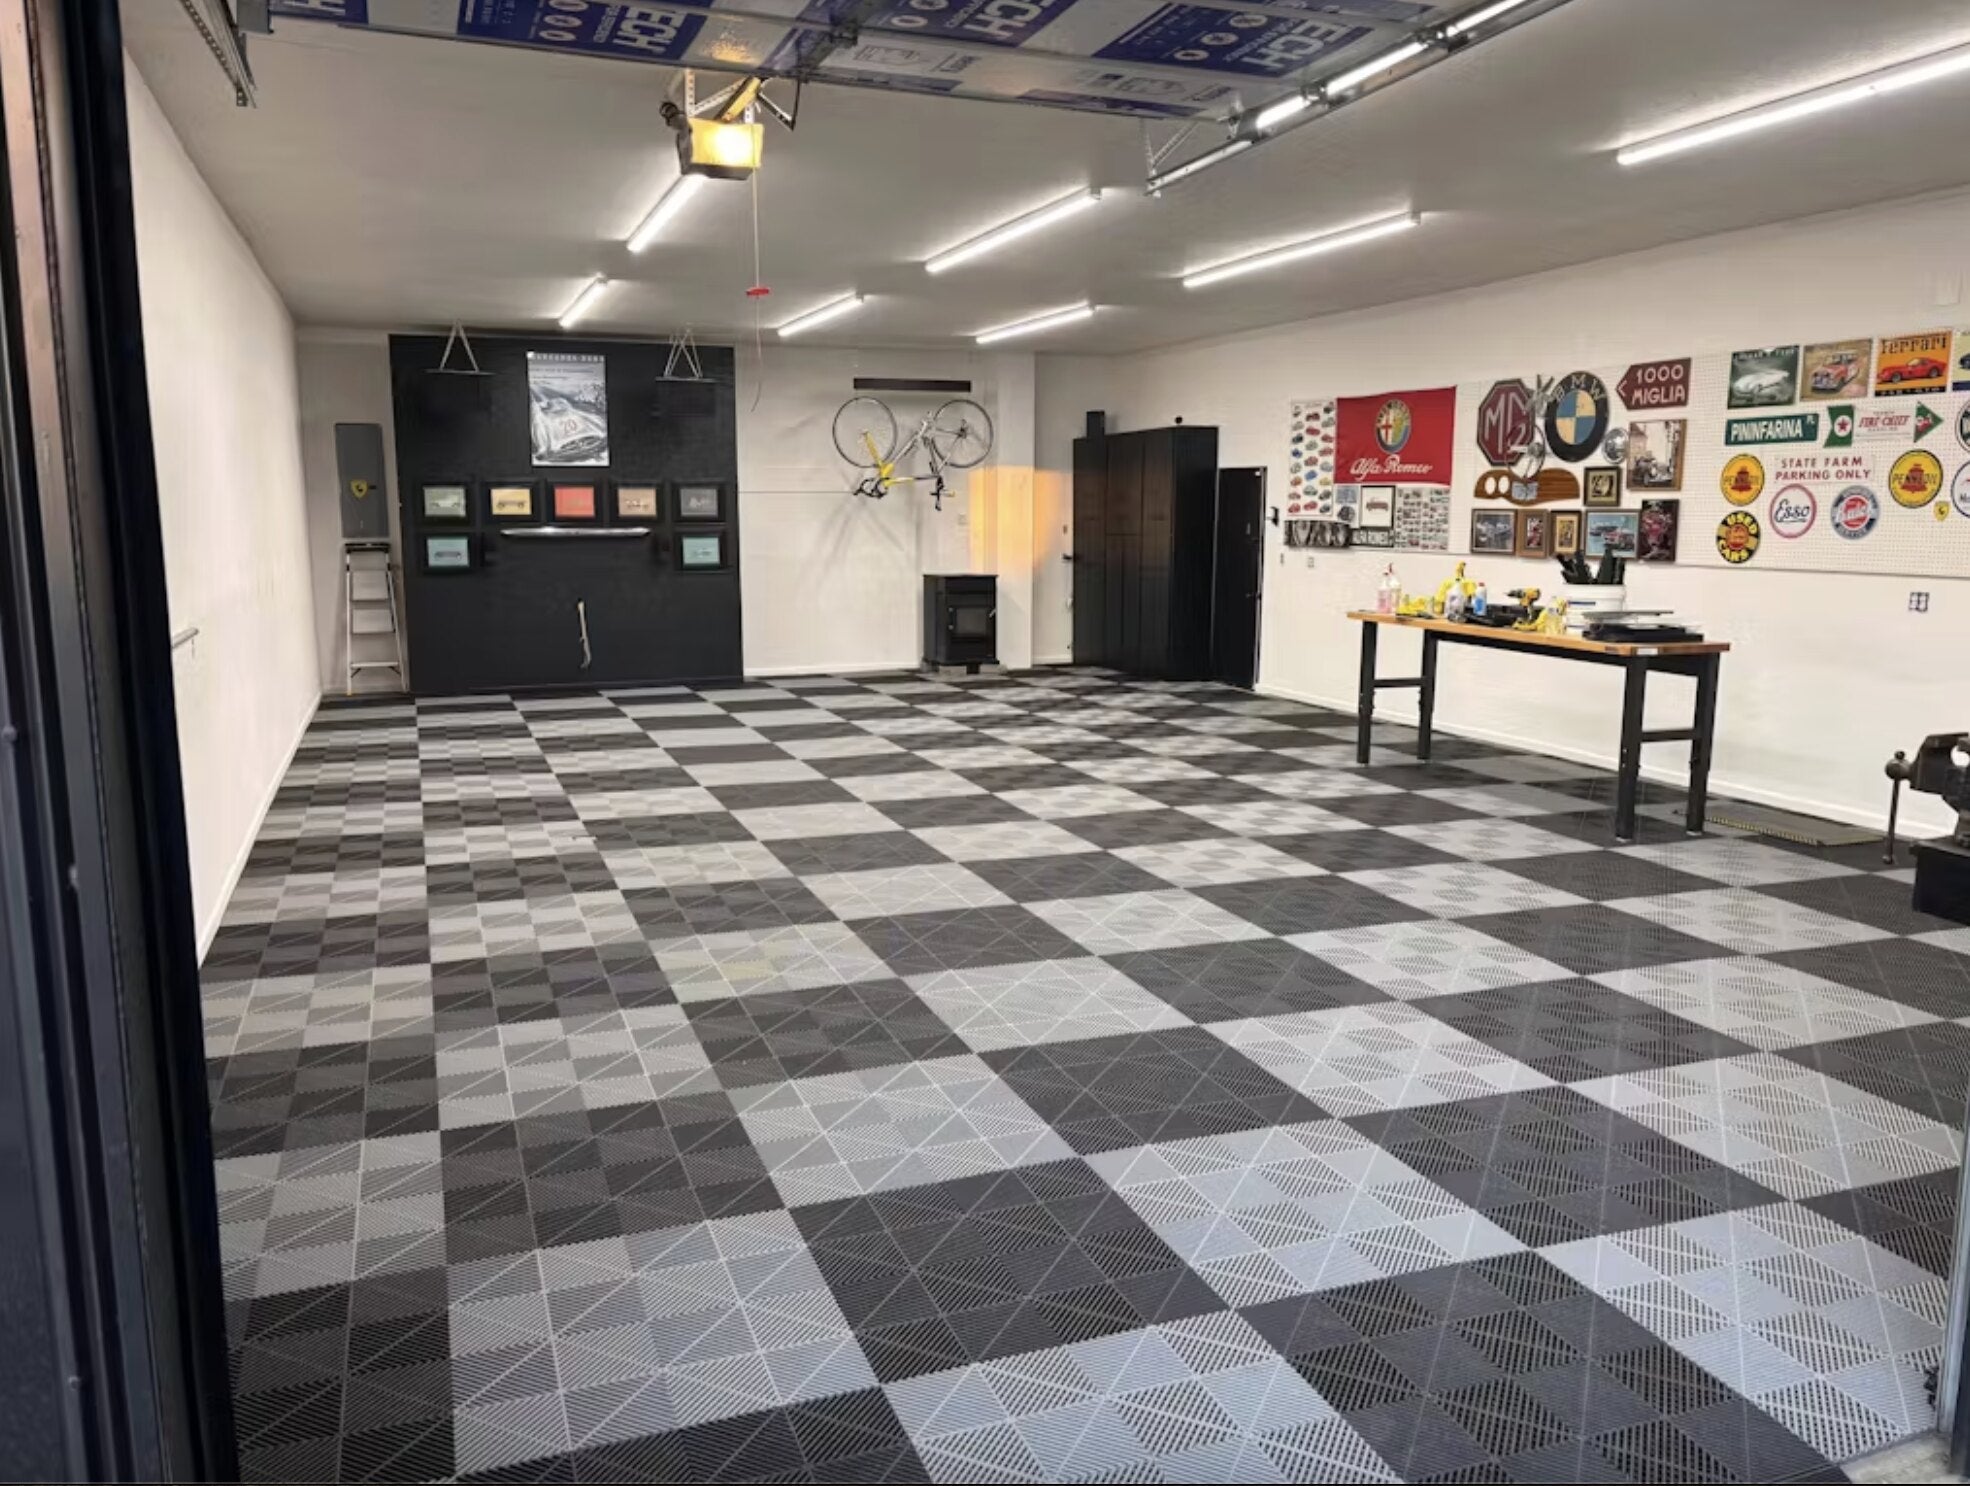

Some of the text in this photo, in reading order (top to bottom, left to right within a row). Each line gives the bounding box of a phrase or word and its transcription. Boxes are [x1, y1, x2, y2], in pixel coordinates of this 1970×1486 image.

[1636, 364, 1684, 384] 1000
[1552, 374, 1608, 403] BMW
[1632, 386, 1686, 405] MIGLIA
[1484, 391, 1529, 455] MG
[1731, 419, 1803, 442] PININFARINA
[1350, 454, 1432, 481] Alfa Romeo
[1781, 456, 1863, 469] STATE FARM
[1775, 469, 1872, 480] PARKING ONLY
[1774, 498, 1810, 523] Esso
[1727, 512, 1758, 535] USED
